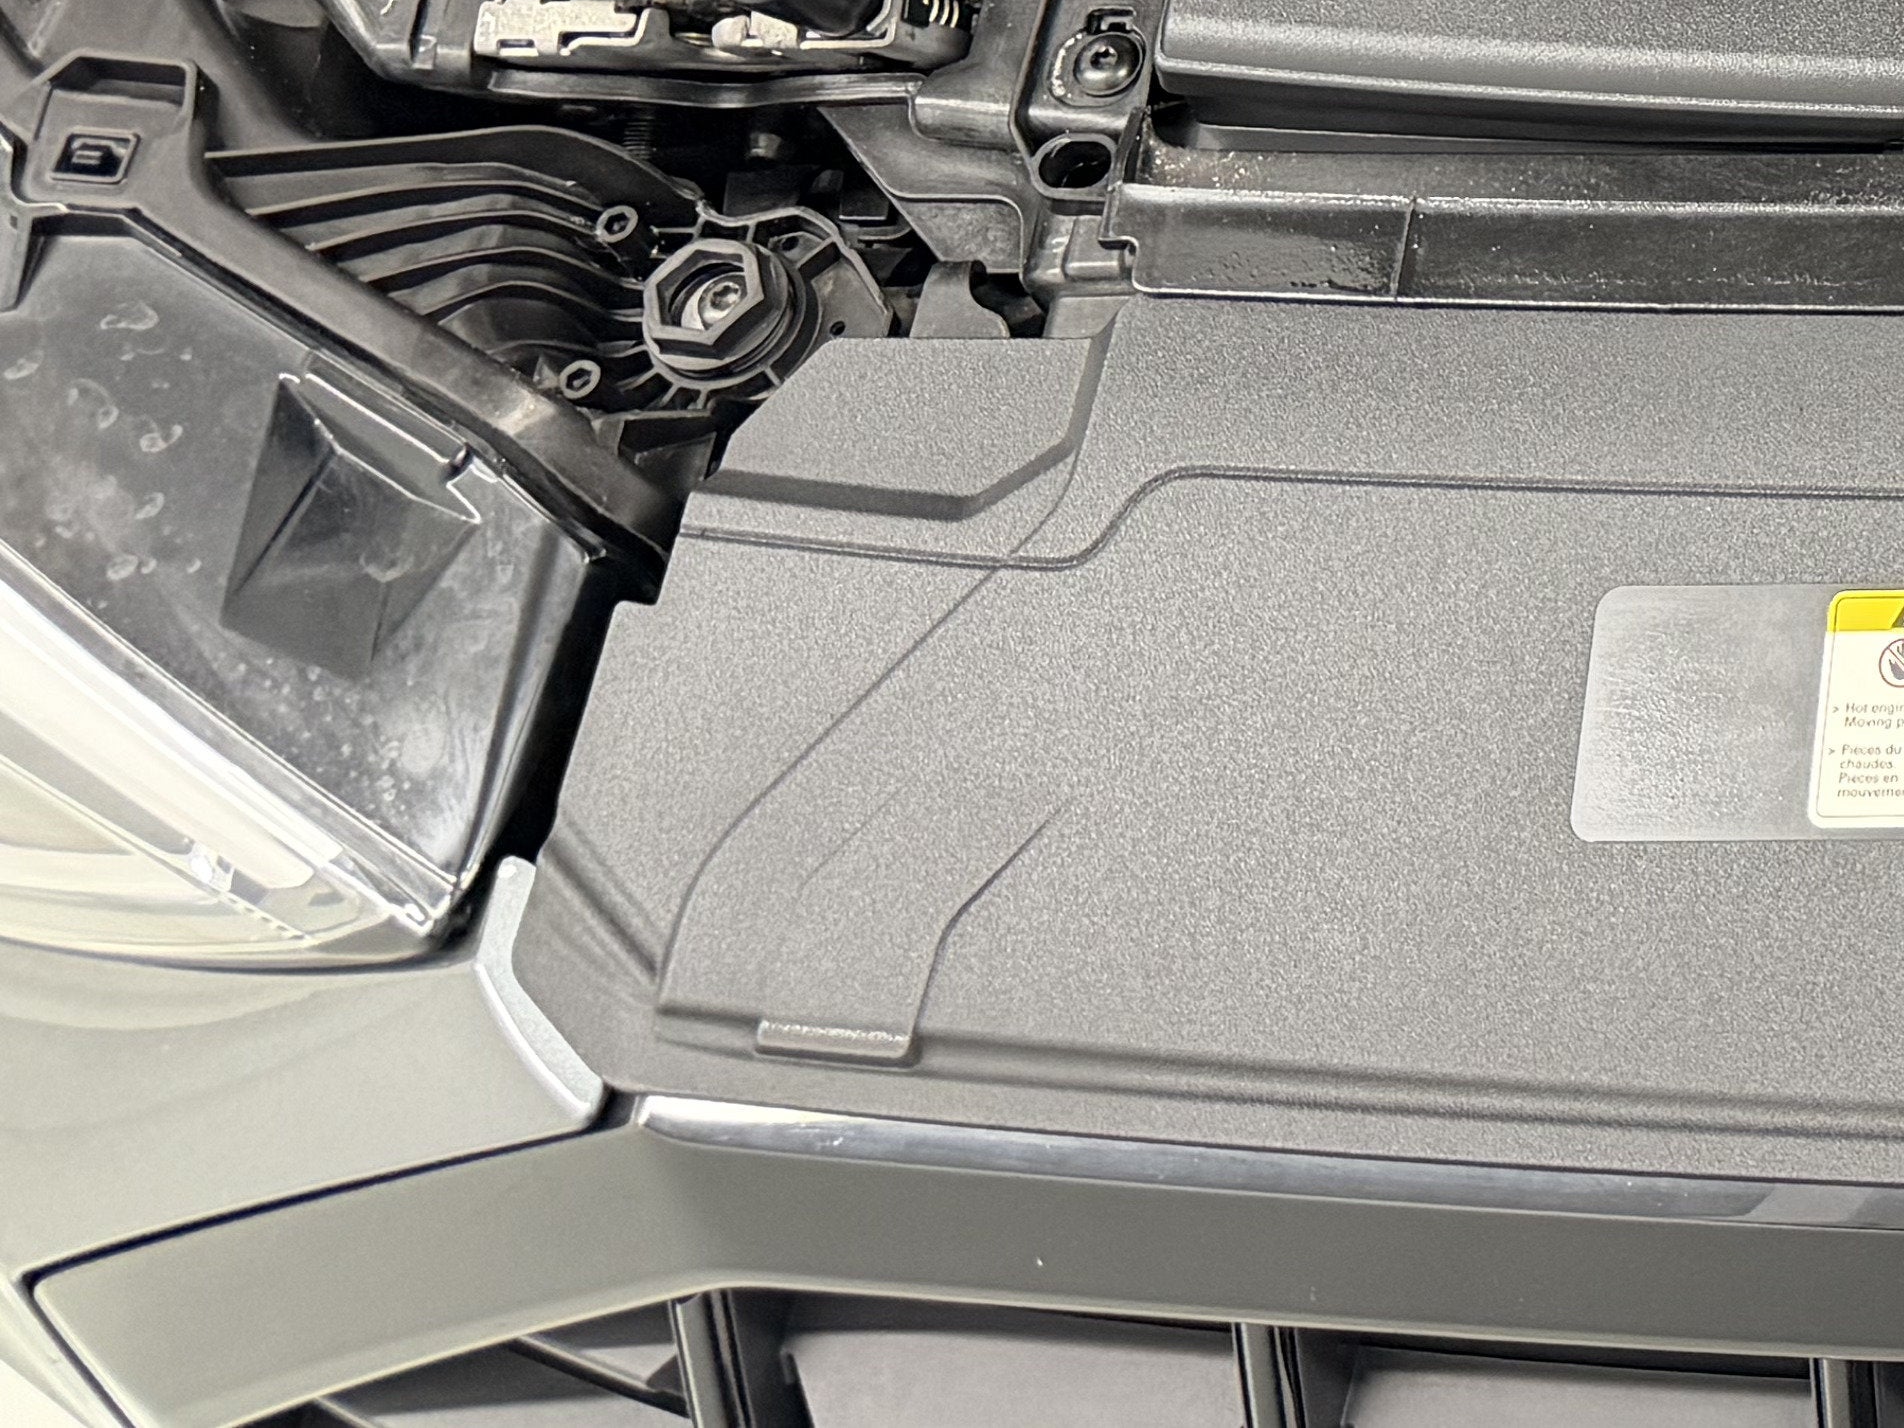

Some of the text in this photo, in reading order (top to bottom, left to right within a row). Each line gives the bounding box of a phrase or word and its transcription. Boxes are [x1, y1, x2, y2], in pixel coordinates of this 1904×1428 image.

[1845, 703, 1868, 713] Hot
[1844, 717, 1892, 729] Moving
[1886, 744, 1902, 755] du
[1883, 775, 1899, 783] en
